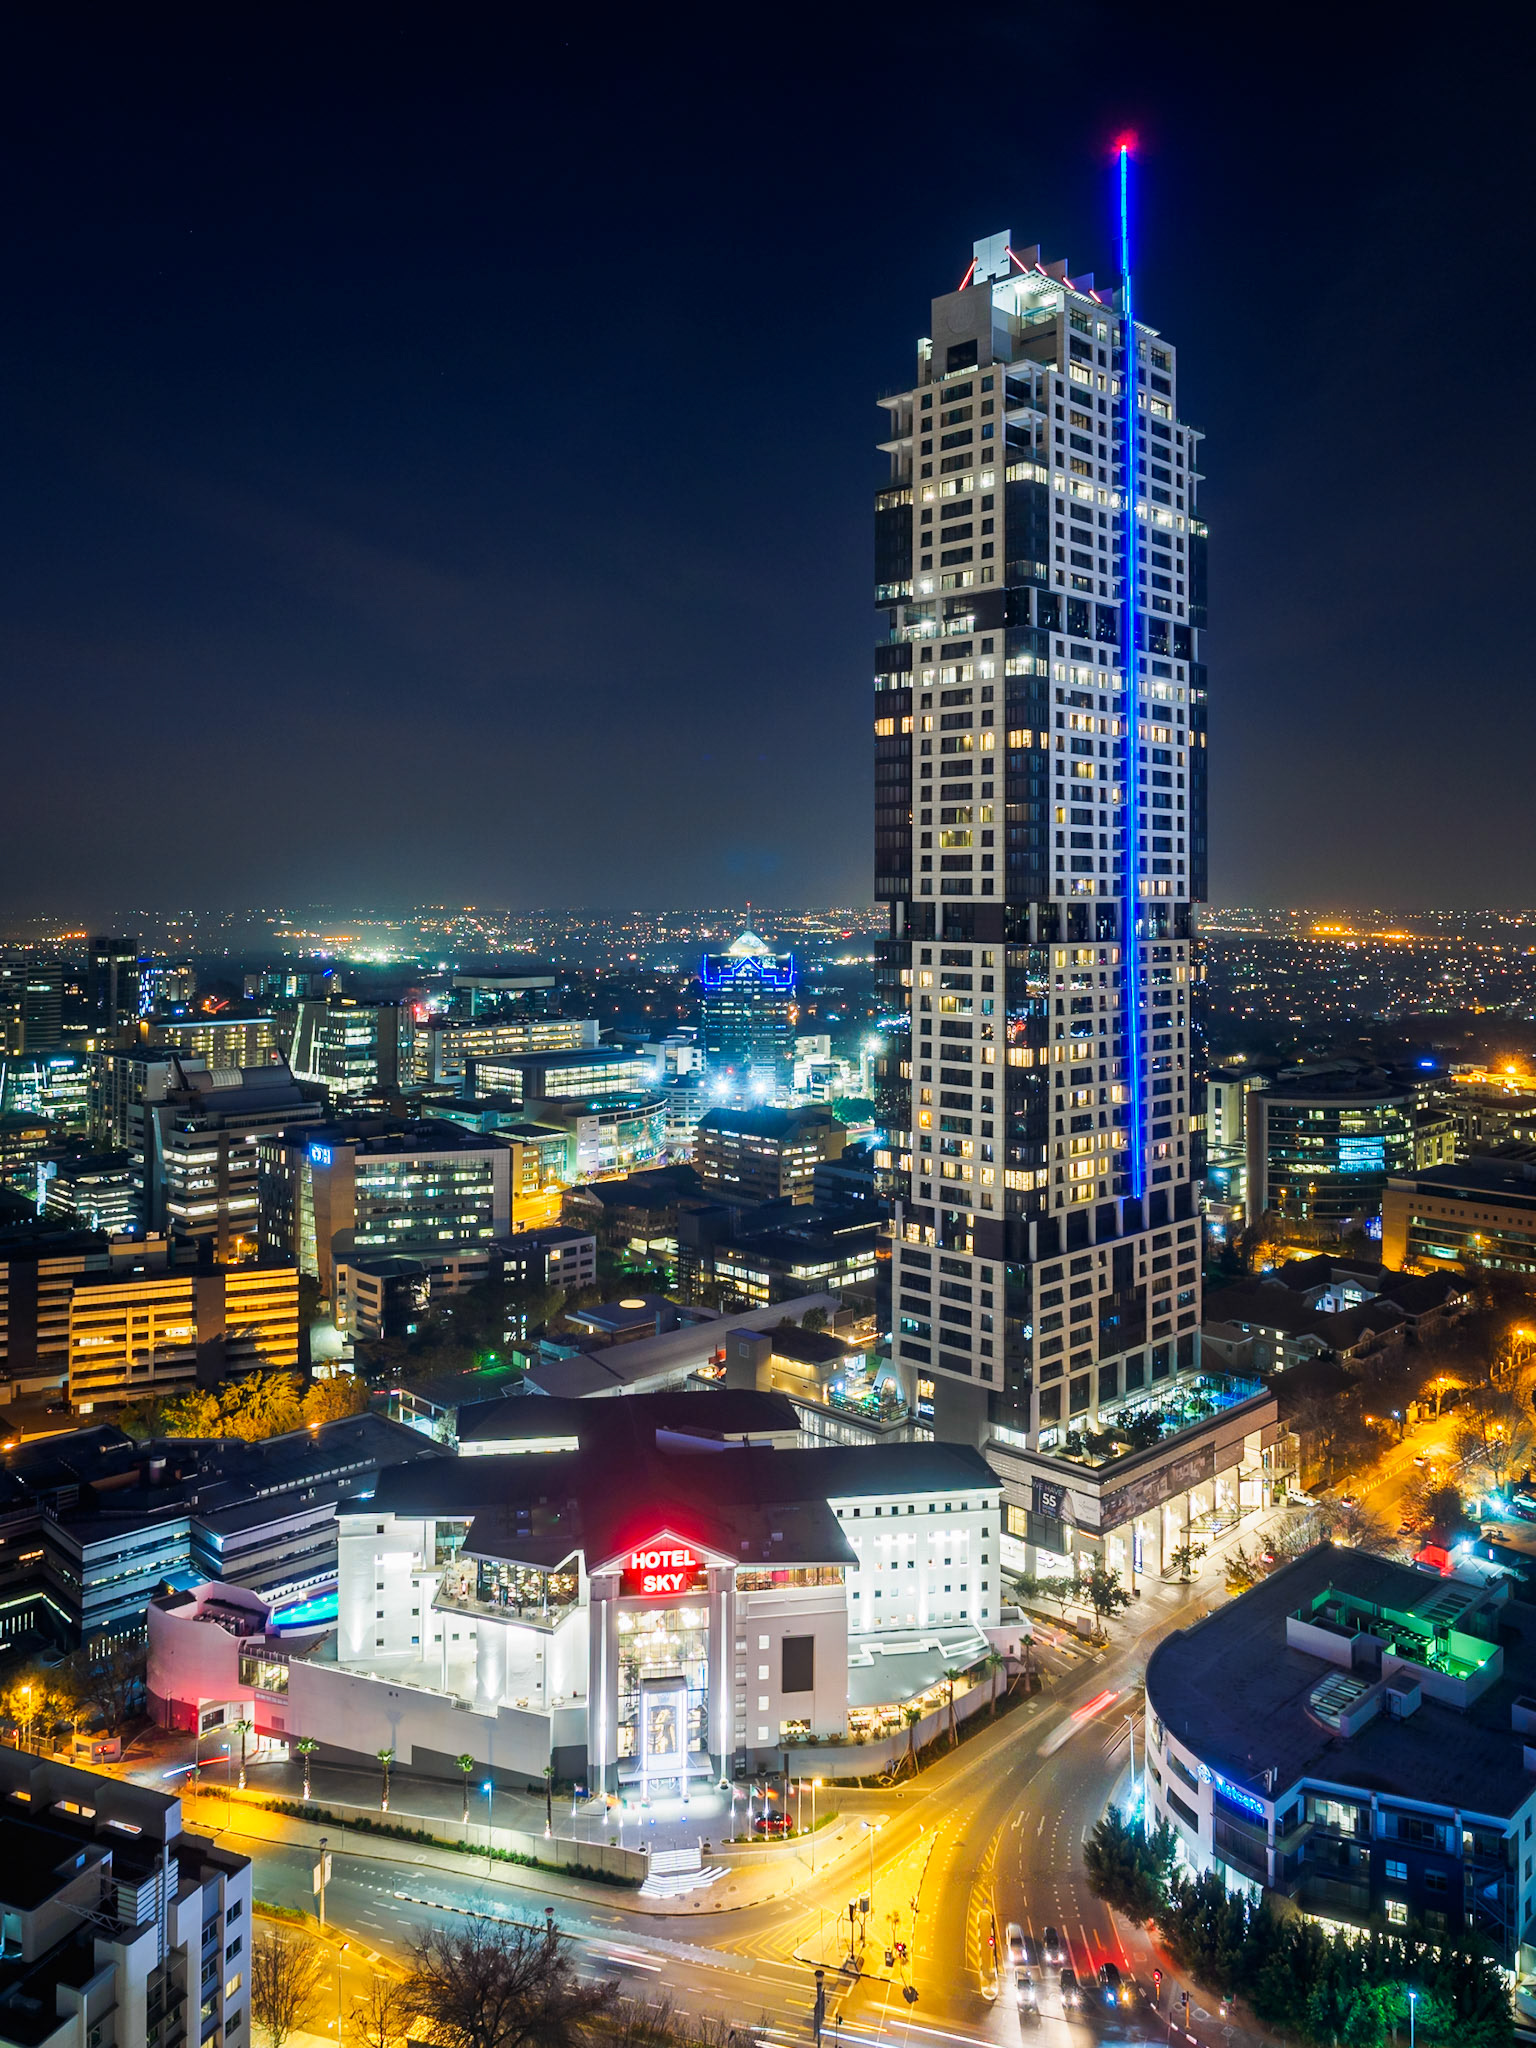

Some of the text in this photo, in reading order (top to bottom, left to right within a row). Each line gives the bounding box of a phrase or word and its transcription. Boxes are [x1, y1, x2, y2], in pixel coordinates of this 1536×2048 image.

[1042, 1492, 1057, 1508] 55
[631, 1550, 696, 1569] HOTEL
[643, 1573, 684, 1592] SKY
